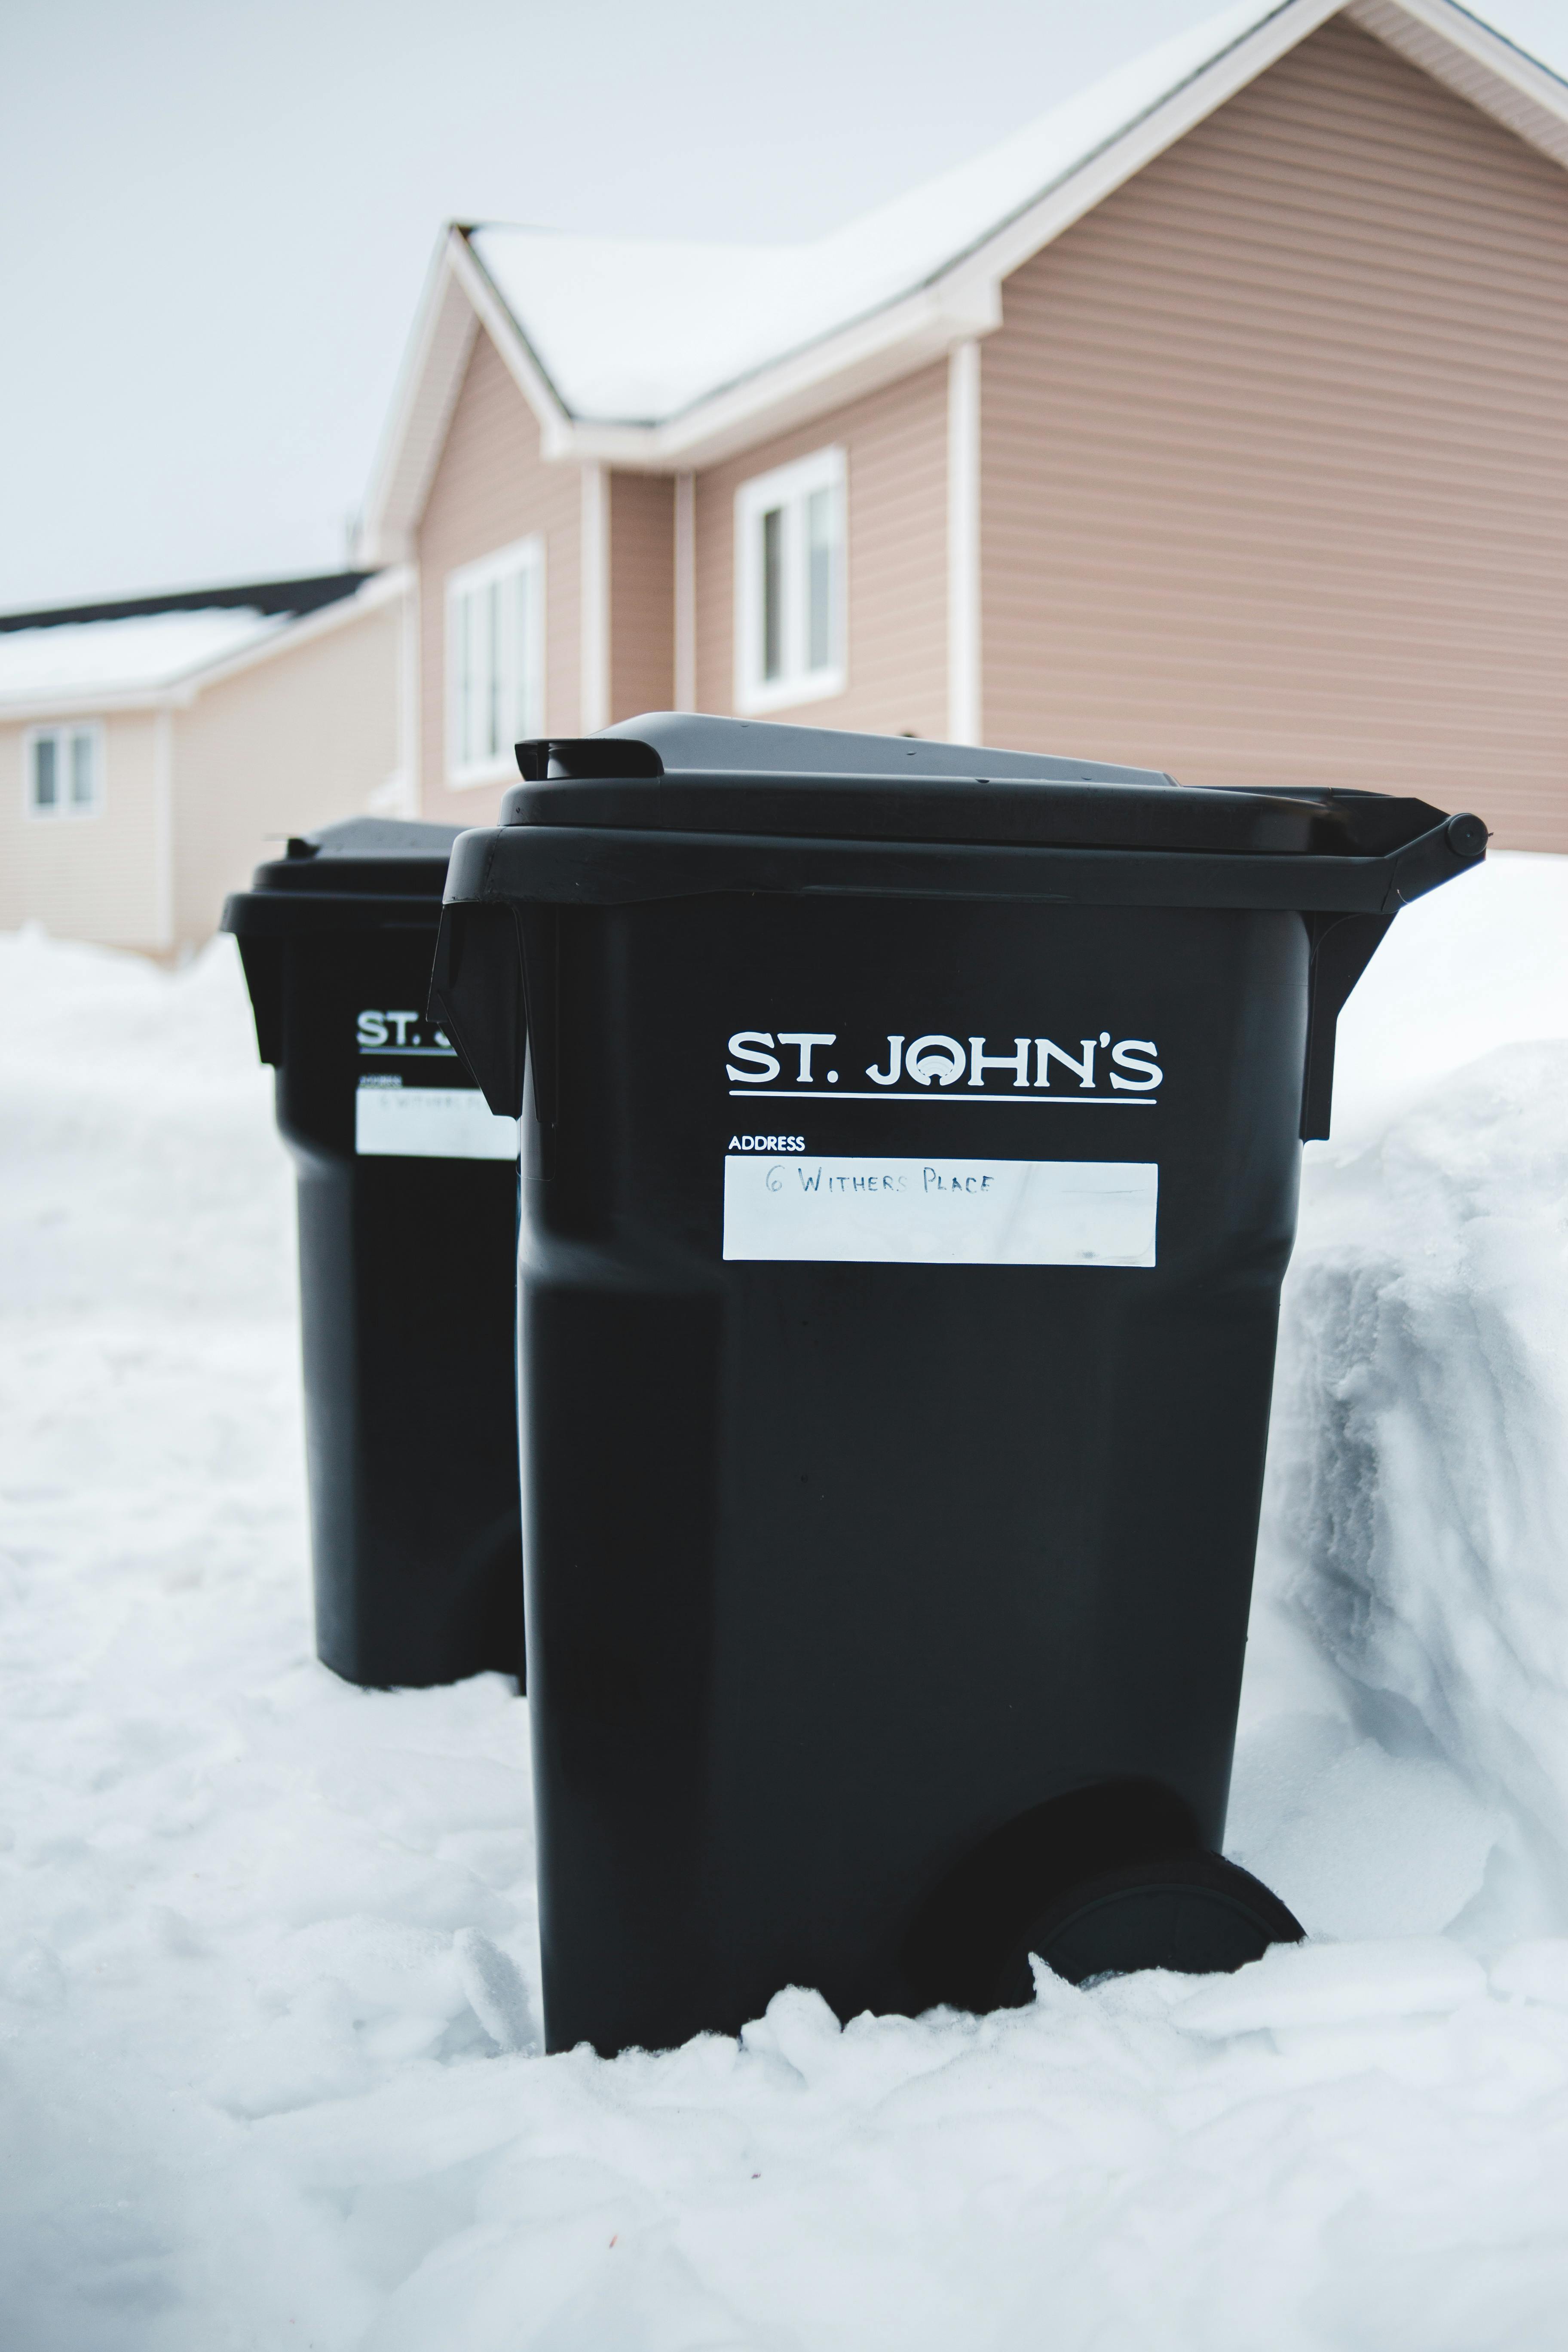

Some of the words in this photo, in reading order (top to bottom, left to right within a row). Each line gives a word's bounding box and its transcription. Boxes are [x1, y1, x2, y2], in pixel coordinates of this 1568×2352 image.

[356, 1010, 420, 1047] ST.
[726, 1032, 839, 1083] ST.
[865, 1032, 1163, 1091] JOHN'S
[728, 1136, 805, 1152] ADDRESS
[766, 1165, 785, 1192] 6
[923, 1167, 994, 1193] PLACE
